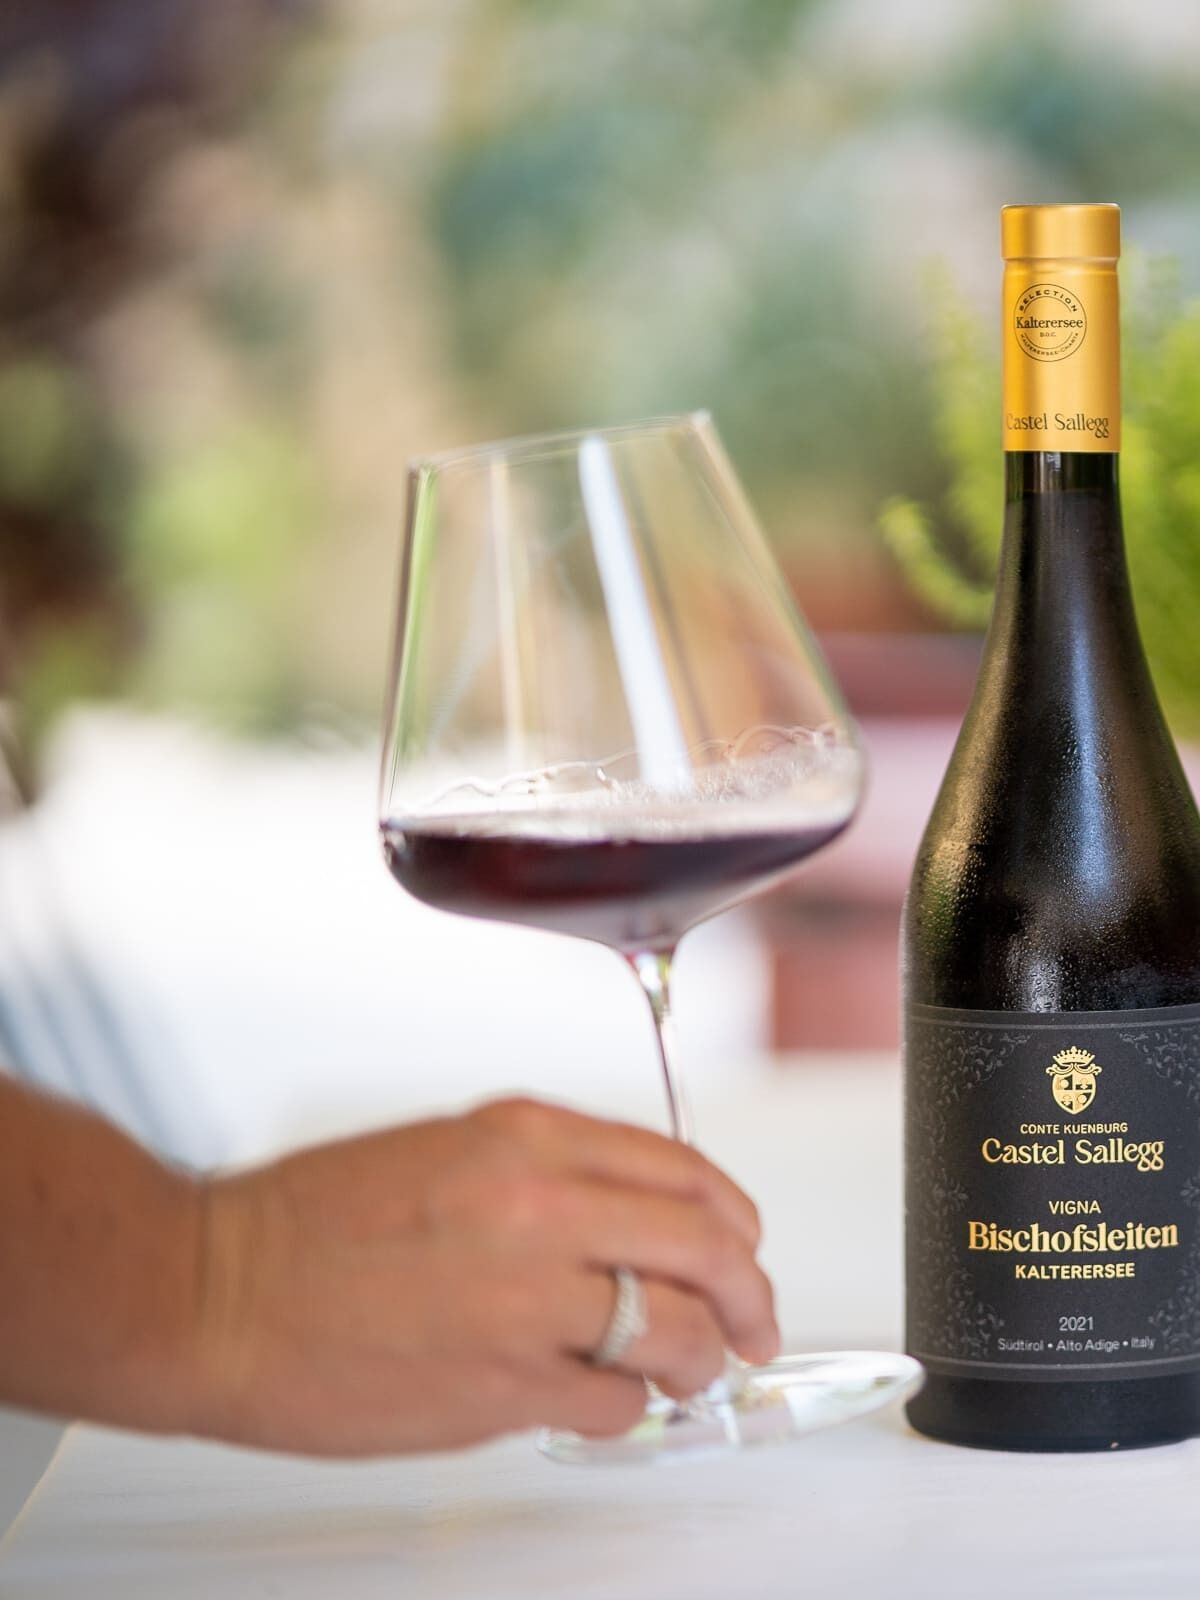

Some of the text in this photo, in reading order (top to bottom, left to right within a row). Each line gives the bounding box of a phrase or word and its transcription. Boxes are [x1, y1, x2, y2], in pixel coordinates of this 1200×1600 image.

[1019, 289, 1077, 312] SELECTION
[1016, 316, 1083, 328] Kalterersee
[1006, 413, 1109, 438] Castel Sallegg
[1020, 1122, 1128, 1135] CONTE KUENBURG
[982, 1138, 1165, 1172] Castel Sallegg
[1048, 1200, 1101, 1215] VIGNA
[968, 1221, 1179, 1252] Bischofsleiten
[1015, 1262, 1136, 1279] KALTERERSEE
[1059, 1316, 1094, 1331] 2021
[998, 1335, 1155, 1353] Südtirol Alto Adige Italy
